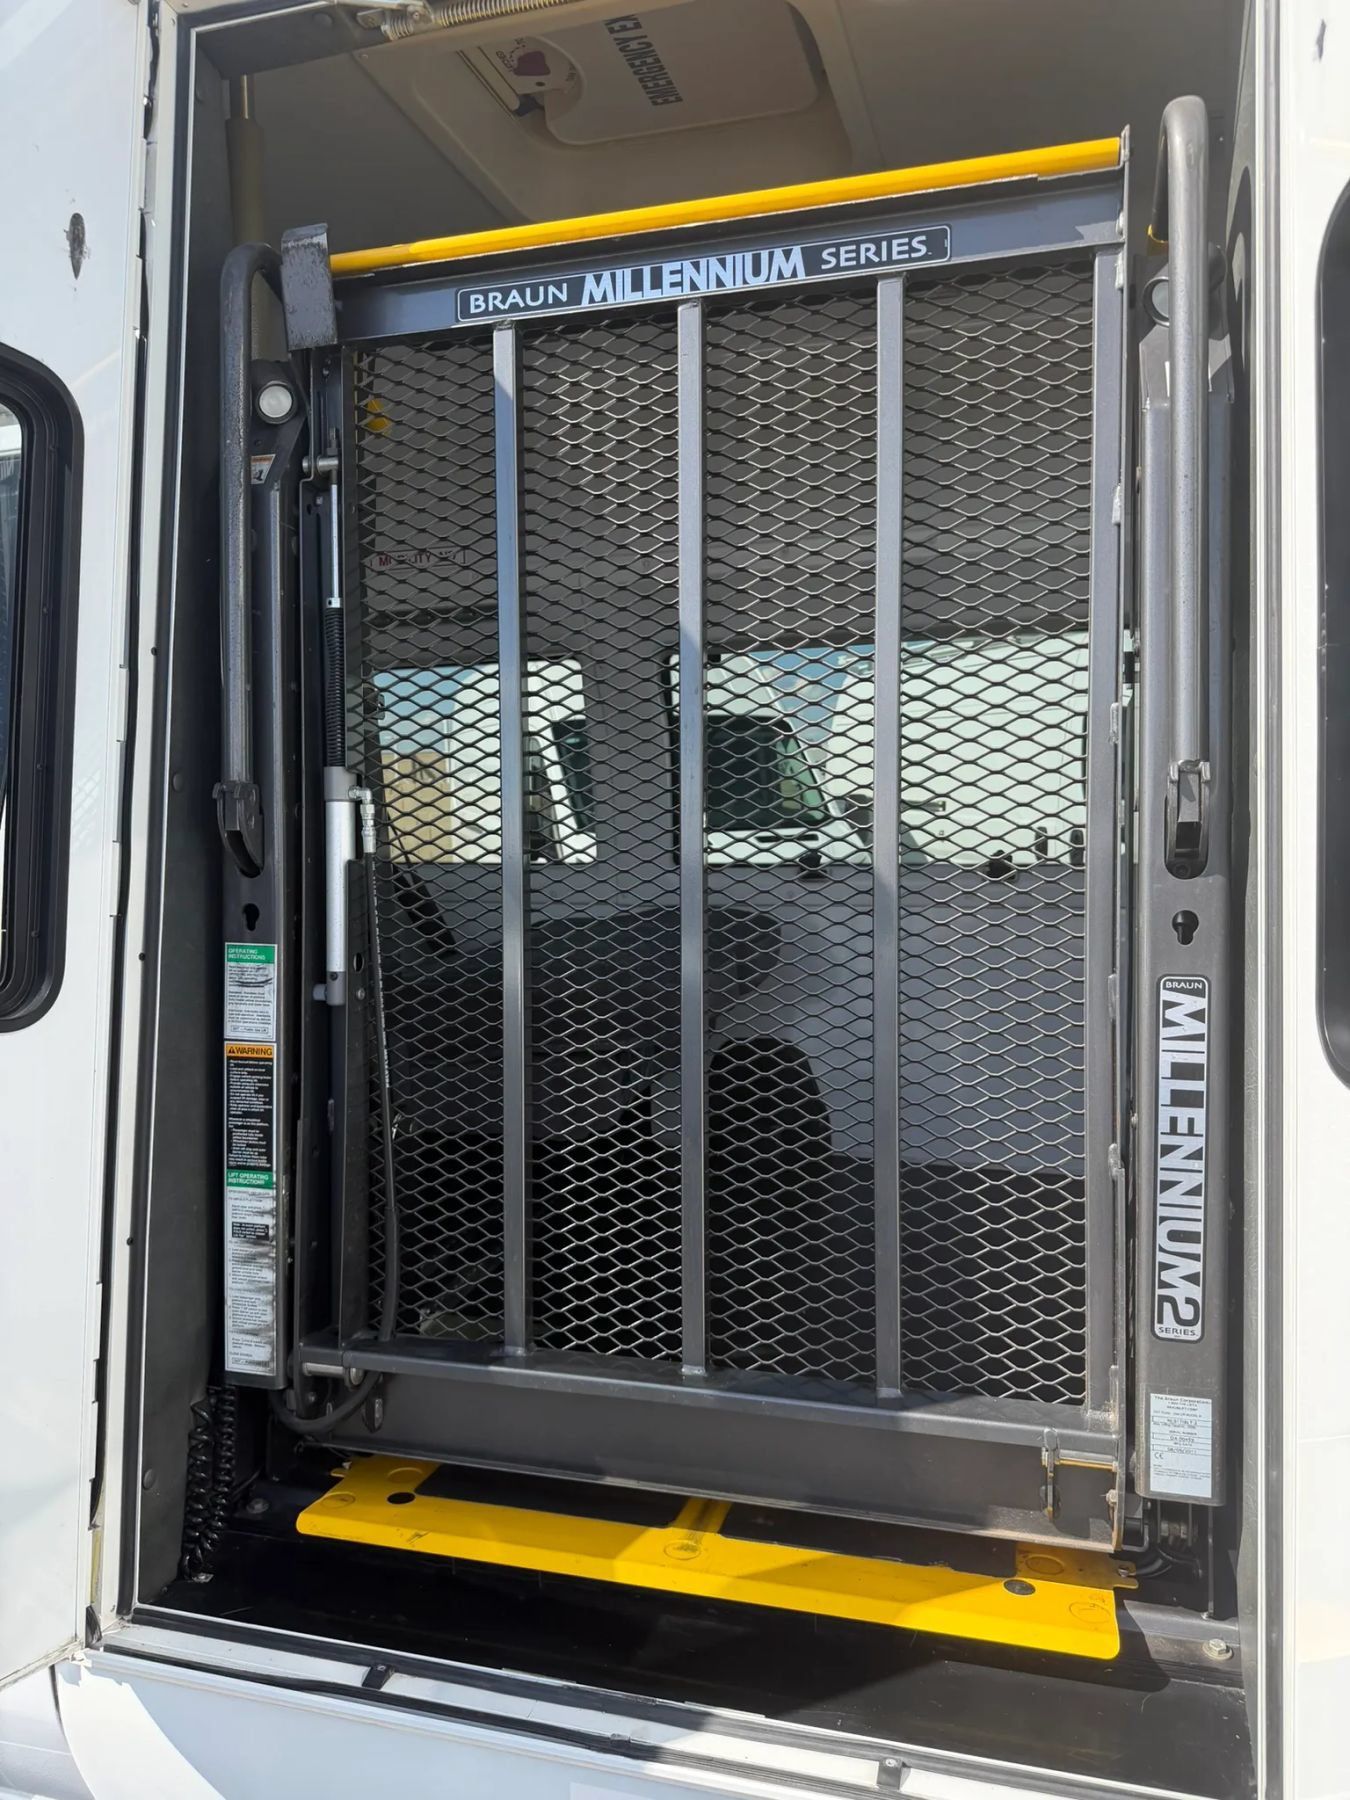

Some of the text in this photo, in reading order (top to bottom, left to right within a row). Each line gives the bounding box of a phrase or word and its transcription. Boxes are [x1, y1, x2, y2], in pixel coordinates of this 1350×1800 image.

[613, 35, 683, 106] EMERGENCY
[469, 235, 928, 314] BRAUN MILLENNIUM SERIES
[1165, 981, 1203, 989] BRAUN
[235, 1046, 273, 1056] WARNING
[1157, 989, 1206, 1297] MILLENNIUM
[1158, 1326, 1197, 1336] SERIES
